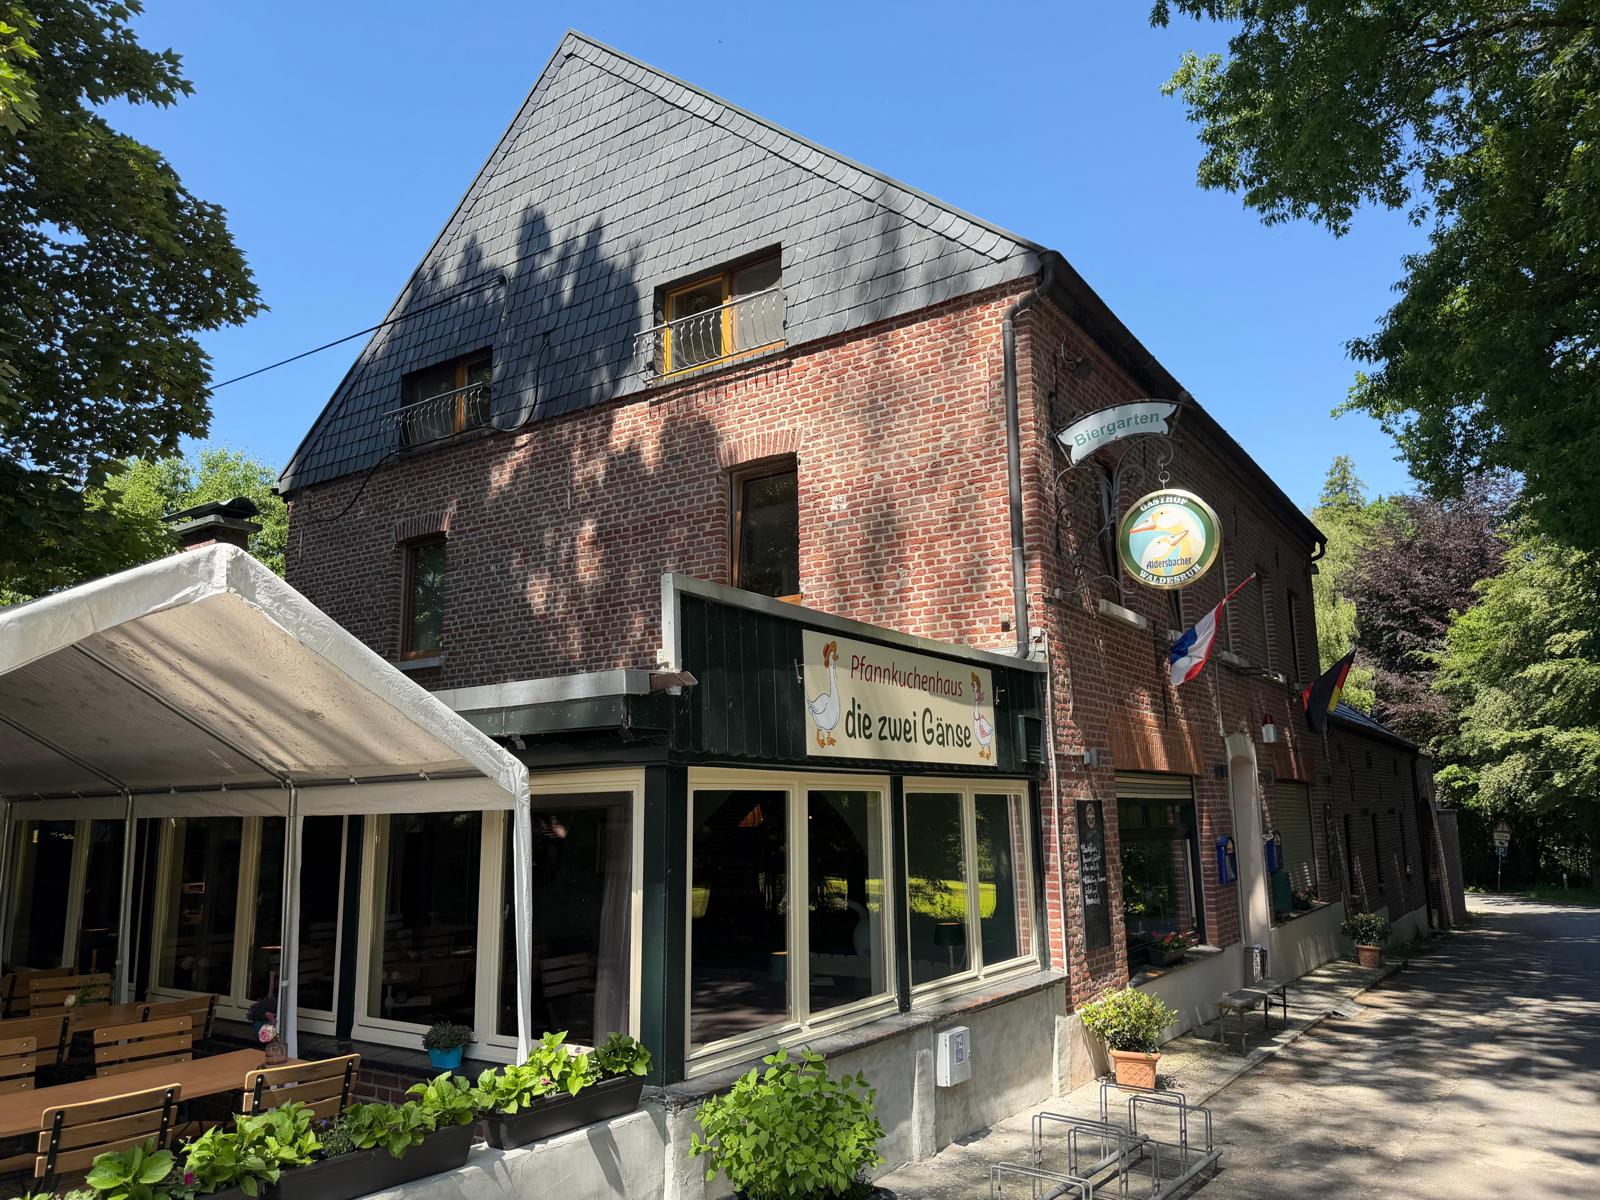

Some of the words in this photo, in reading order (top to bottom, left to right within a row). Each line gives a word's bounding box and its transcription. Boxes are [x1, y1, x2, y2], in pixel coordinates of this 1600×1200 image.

[1074, 413, 1160, 447] Biergarten
[1140, 496, 1187, 512] GASTHOF
[1139, 564, 1202, 584] WALDESRUH
[1146, 557, 1192, 570] Aldersbacher
[851, 655, 963, 697] Pfannkuchenhaus
[845, 697, 873, 740] die
[878, 711, 918, 744] zwei
[922, 707, 972, 748] Gänse
